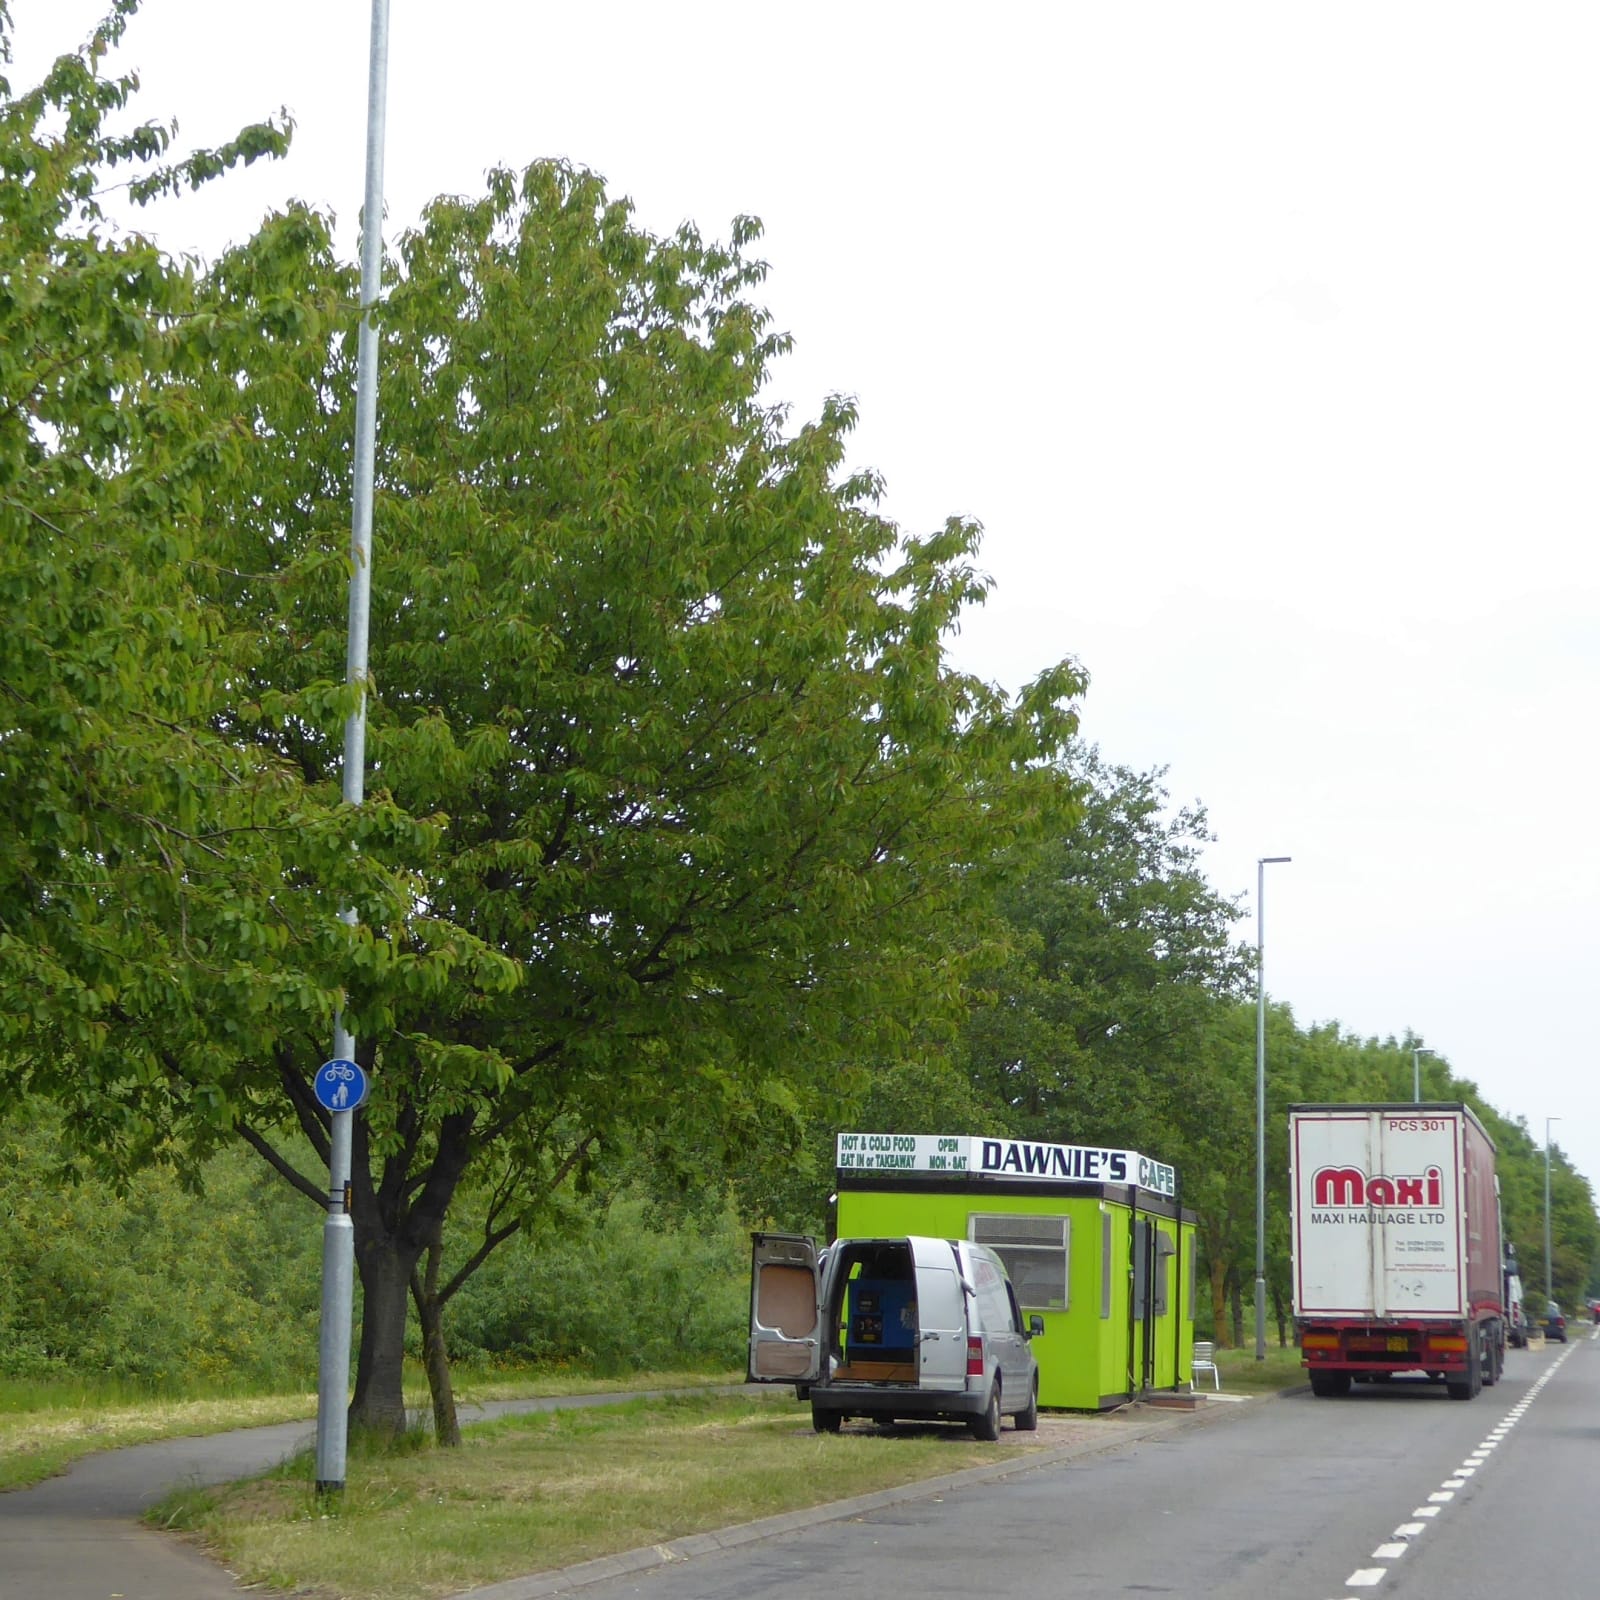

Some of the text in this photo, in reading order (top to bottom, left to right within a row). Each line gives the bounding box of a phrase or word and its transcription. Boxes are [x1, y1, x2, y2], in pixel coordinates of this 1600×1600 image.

[1389, 1120, 1446, 1132] PCS 301
[841, 1135, 916, 1152] HOT & COLD FOOD
[938, 1138, 959, 1152] OPEN
[840, 1153, 916, 1168] EAT IN or TAKEAWAY
[929, 1155, 947, 1168] MON
[952, 1155, 967, 1169] SAT
[981, 1140, 1127, 1181] DAWNIE'S
[1138, 1157, 1174, 1193] CAFE
[1311, 1213, 1446, 1225] MAXI HAULAGE LTD
